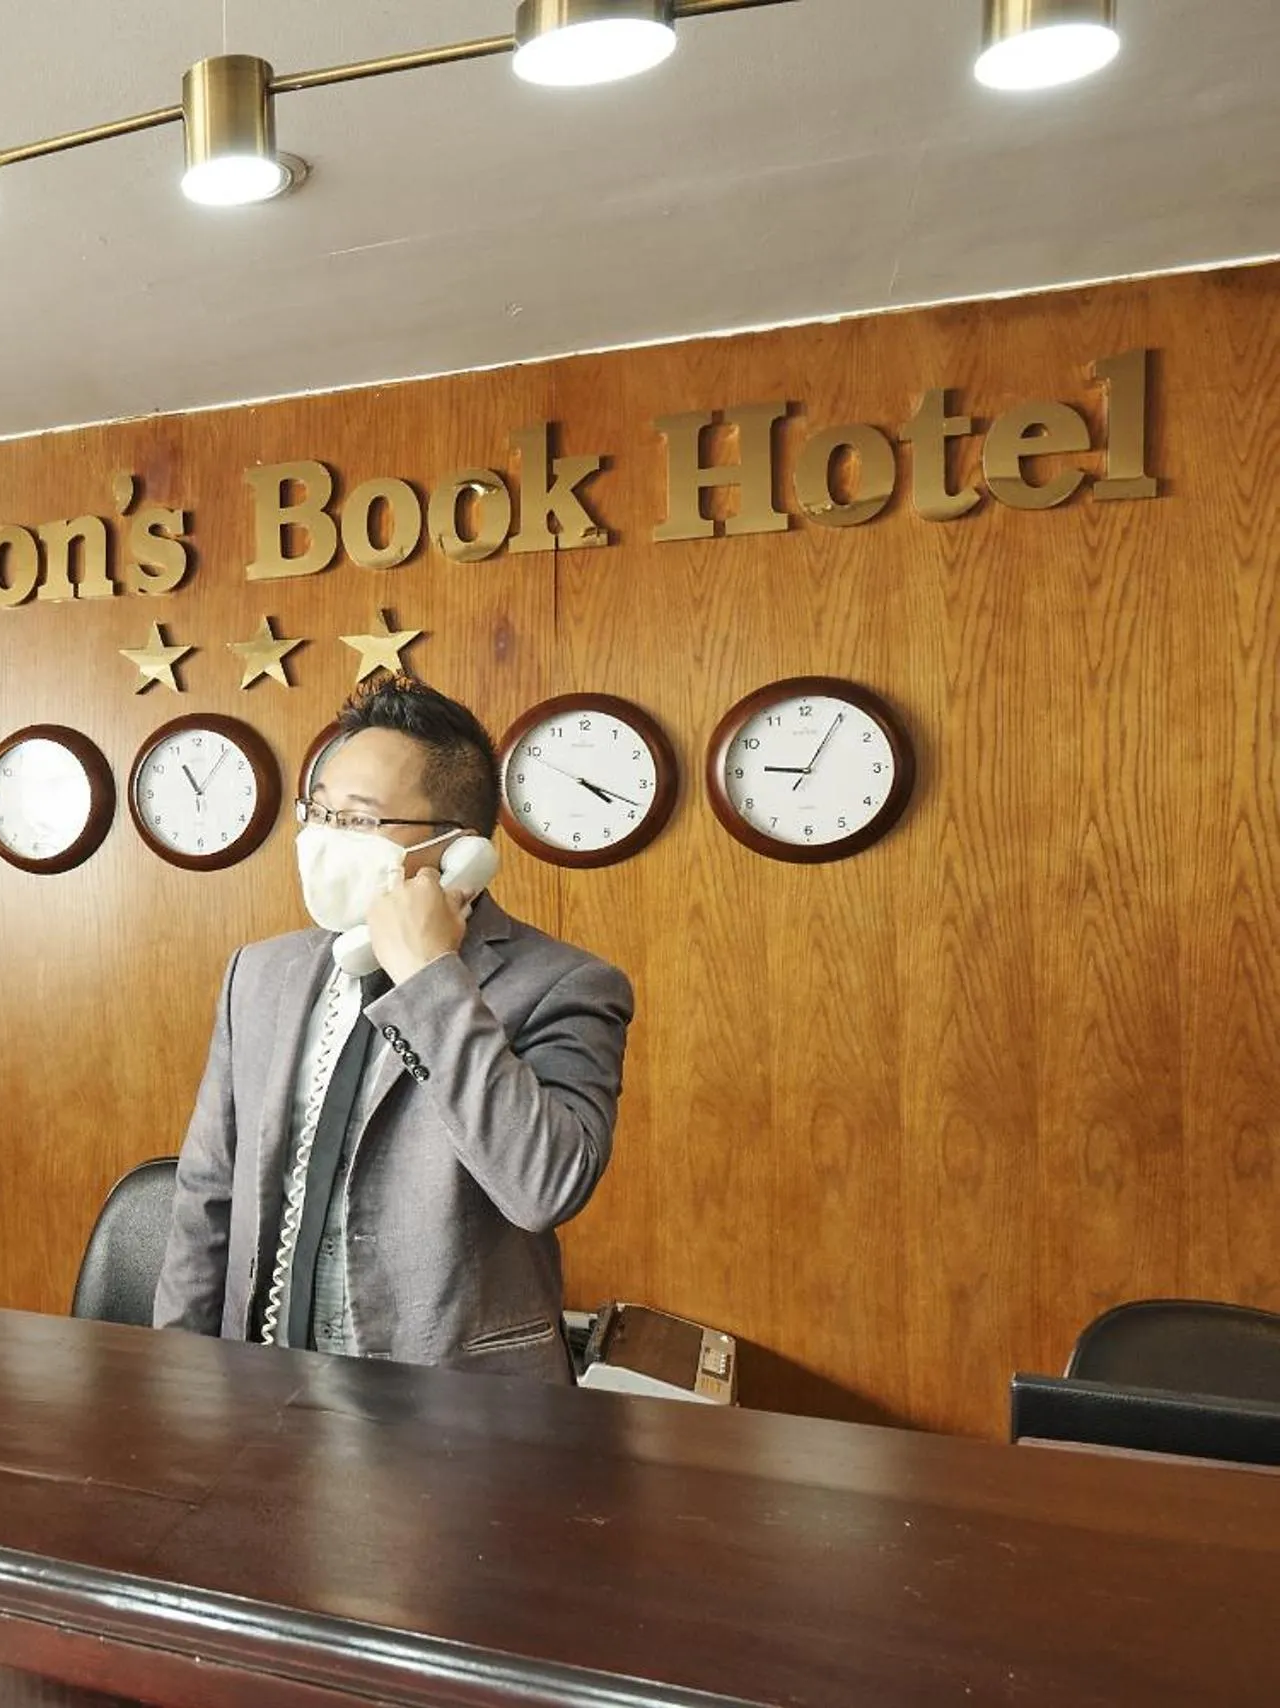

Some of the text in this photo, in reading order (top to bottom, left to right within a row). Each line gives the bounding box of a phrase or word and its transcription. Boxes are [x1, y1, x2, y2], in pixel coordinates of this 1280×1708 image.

[244, 421, 609, 581] Book
[653, 347, 1157, 544] Hotel
[799, 706, 812, 716] 12
[578, 720, 591, 731] 12
[767, 716, 781, 726] 11
[551, 728, 563, 737] 11
[863, 732, 871, 742] 2
[192, 737, 202, 747] 12
[743, 739, 760, 750] 10
[170, 746, 180, 755] 11
[527, 746, 542, 757] 10
[632, 750, 641, 760] 2
[238, 761, 245, 770] 2
[872, 762, 882, 773] 3
[734, 768, 744, 779] 9
[517, 774, 524, 784] 9
[639, 779, 647, 789] 3
[147, 790, 154, 799] 9
[745, 798, 754, 809] 8
[863, 796, 871, 806] 4
[523, 802, 531, 812] 8
[238, 814, 245, 822] 4
[627, 810, 636, 820] 4
[154, 816, 161, 825] 8
[770, 817, 779, 828] 7
[838, 817, 846, 828] 5
[543, 822, 551, 832] 7
[804, 826, 813, 836] 6
[172, 832, 178, 840] 7
[221, 832, 228, 842] 5
[573, 832, 581, 842] 6
[603, 828, 611, 838] 5
[197, 837, 204, 847] 6
